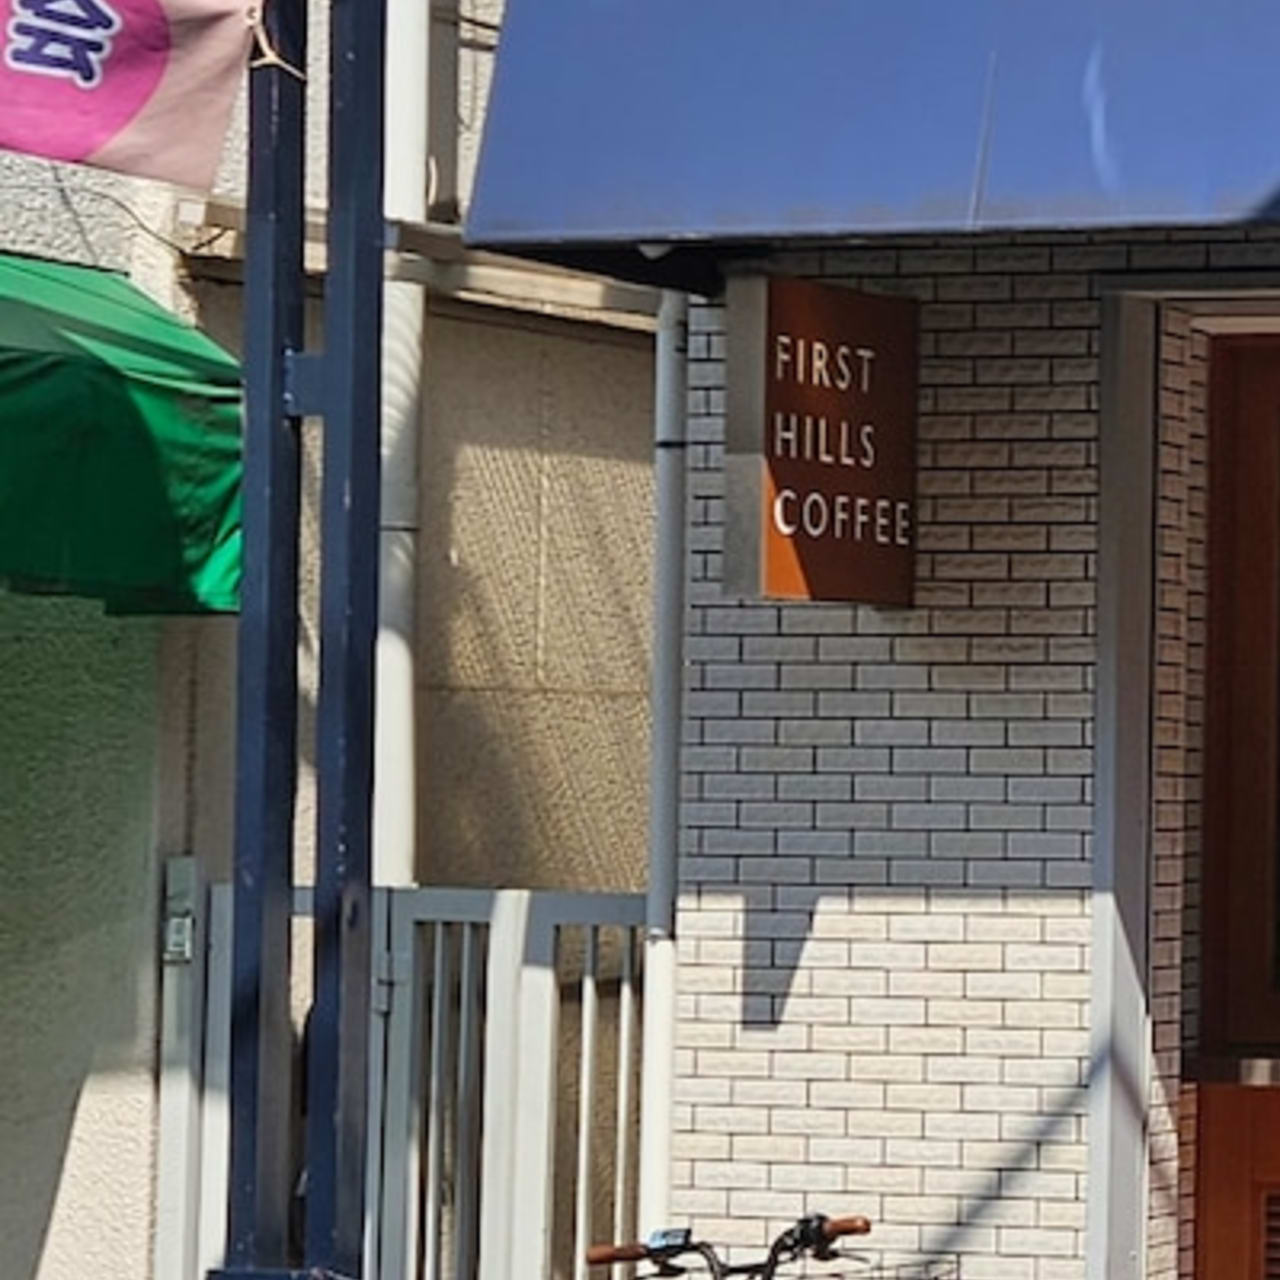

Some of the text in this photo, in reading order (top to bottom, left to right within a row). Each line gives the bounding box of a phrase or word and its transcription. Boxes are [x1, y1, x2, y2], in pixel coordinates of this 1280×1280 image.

[776, 334, 875, 393] FIRST
[775, 412, 875, 469] HILLS
[773, 488, 910, 545] COFFEE
